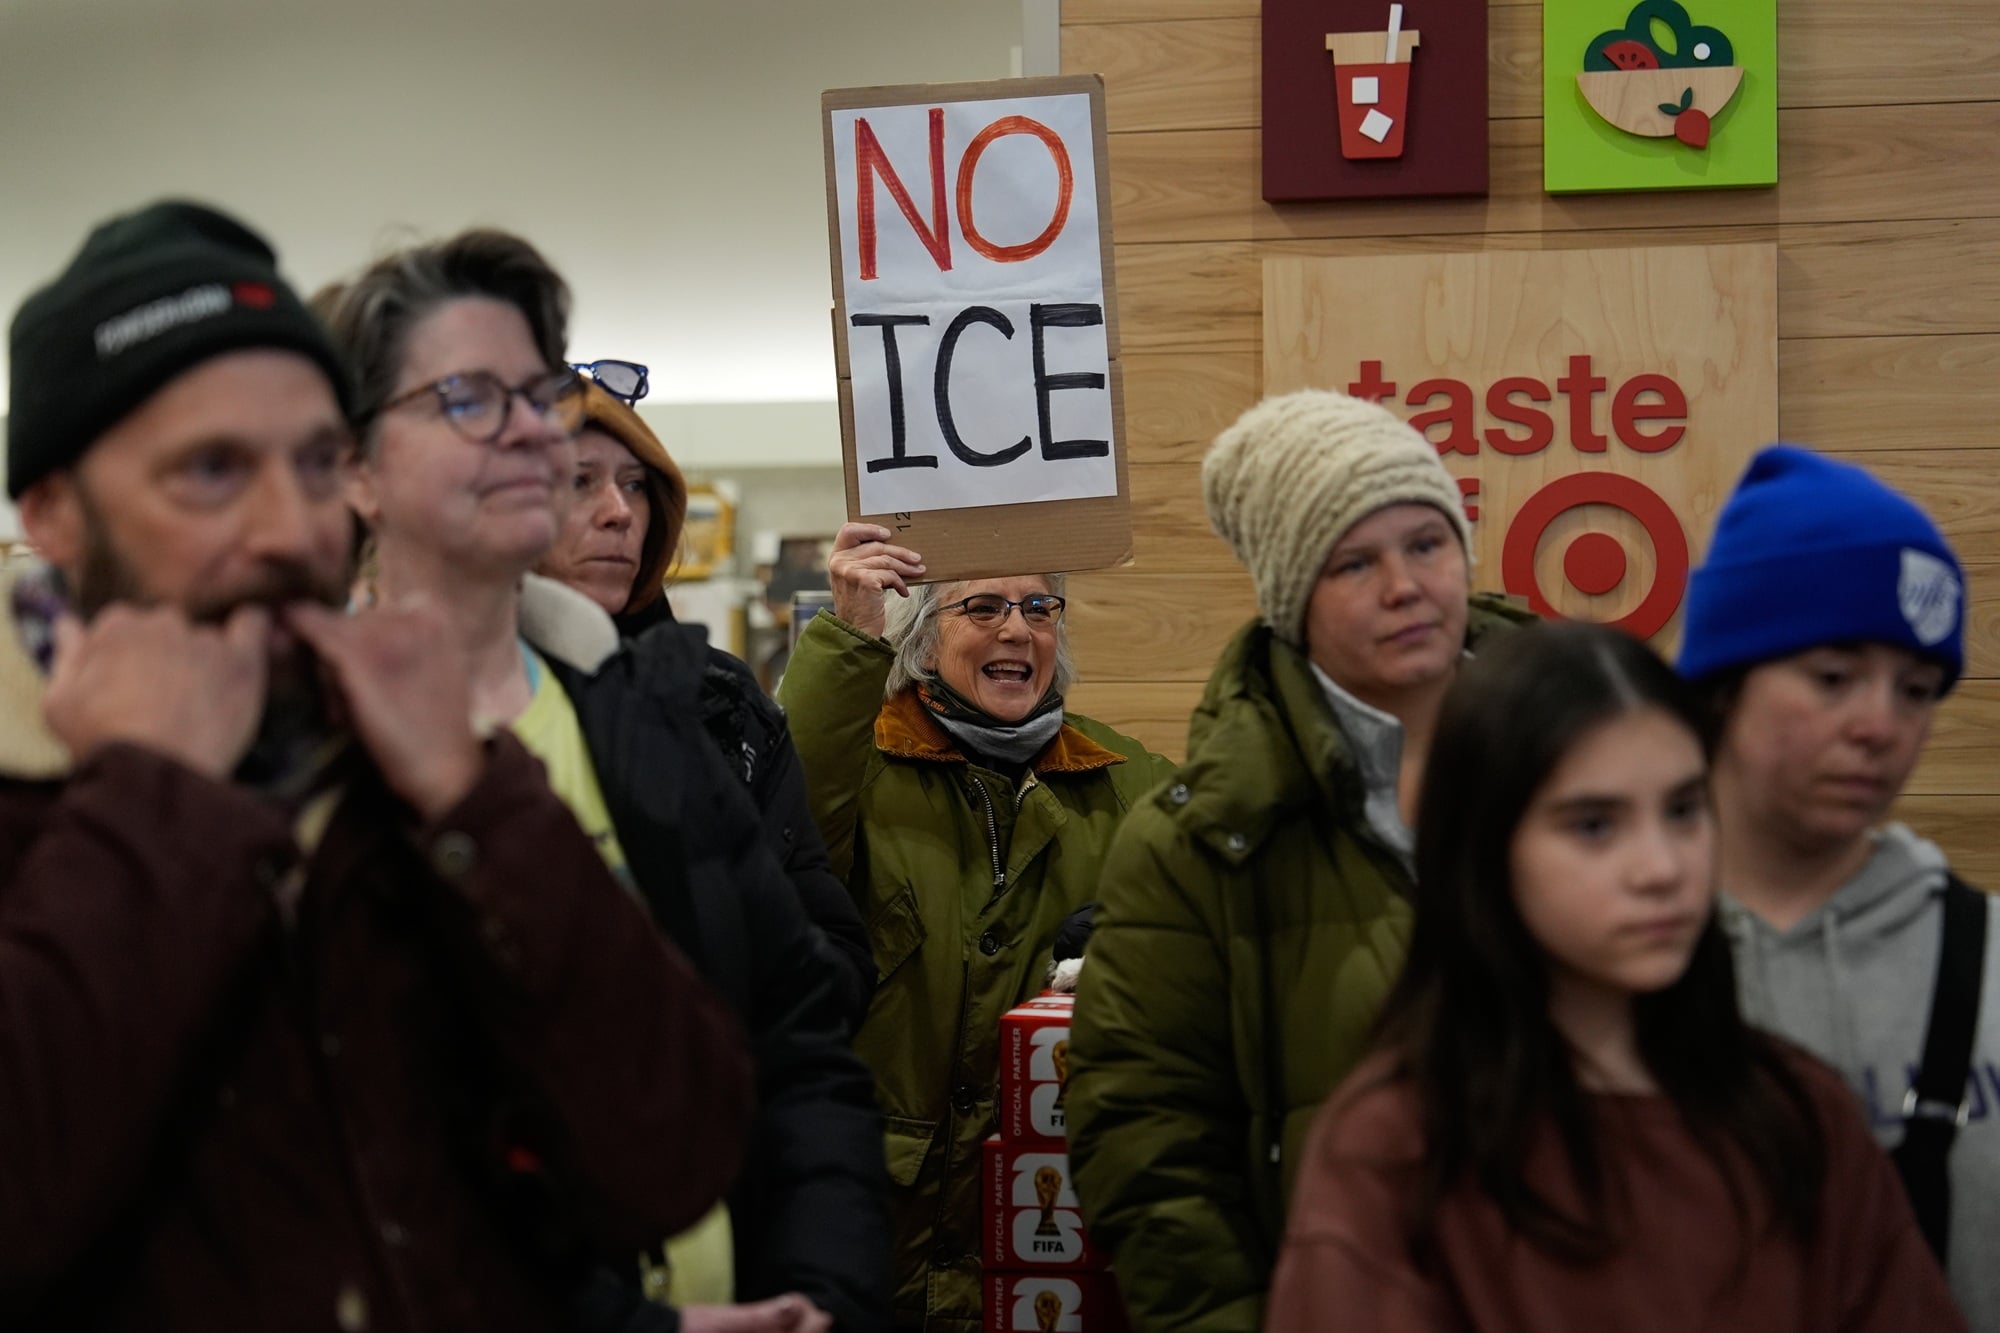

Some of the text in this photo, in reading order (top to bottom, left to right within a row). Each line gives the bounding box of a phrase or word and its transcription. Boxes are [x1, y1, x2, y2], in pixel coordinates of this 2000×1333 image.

[855, 108, 1073, 280] NO
[851, 303, 1109, 473] ICE
[1012, 1028, 1022, 1136] OFFICIAL PARTNER
[1051, 1115, 1064, 1127] FI
[994, 1154, 1004, 1262] OFFICIAL PARTNER
[1033, 1240, 1065, 1253] FIFA
[994, 1278, 1004, 1330] PARTNER
